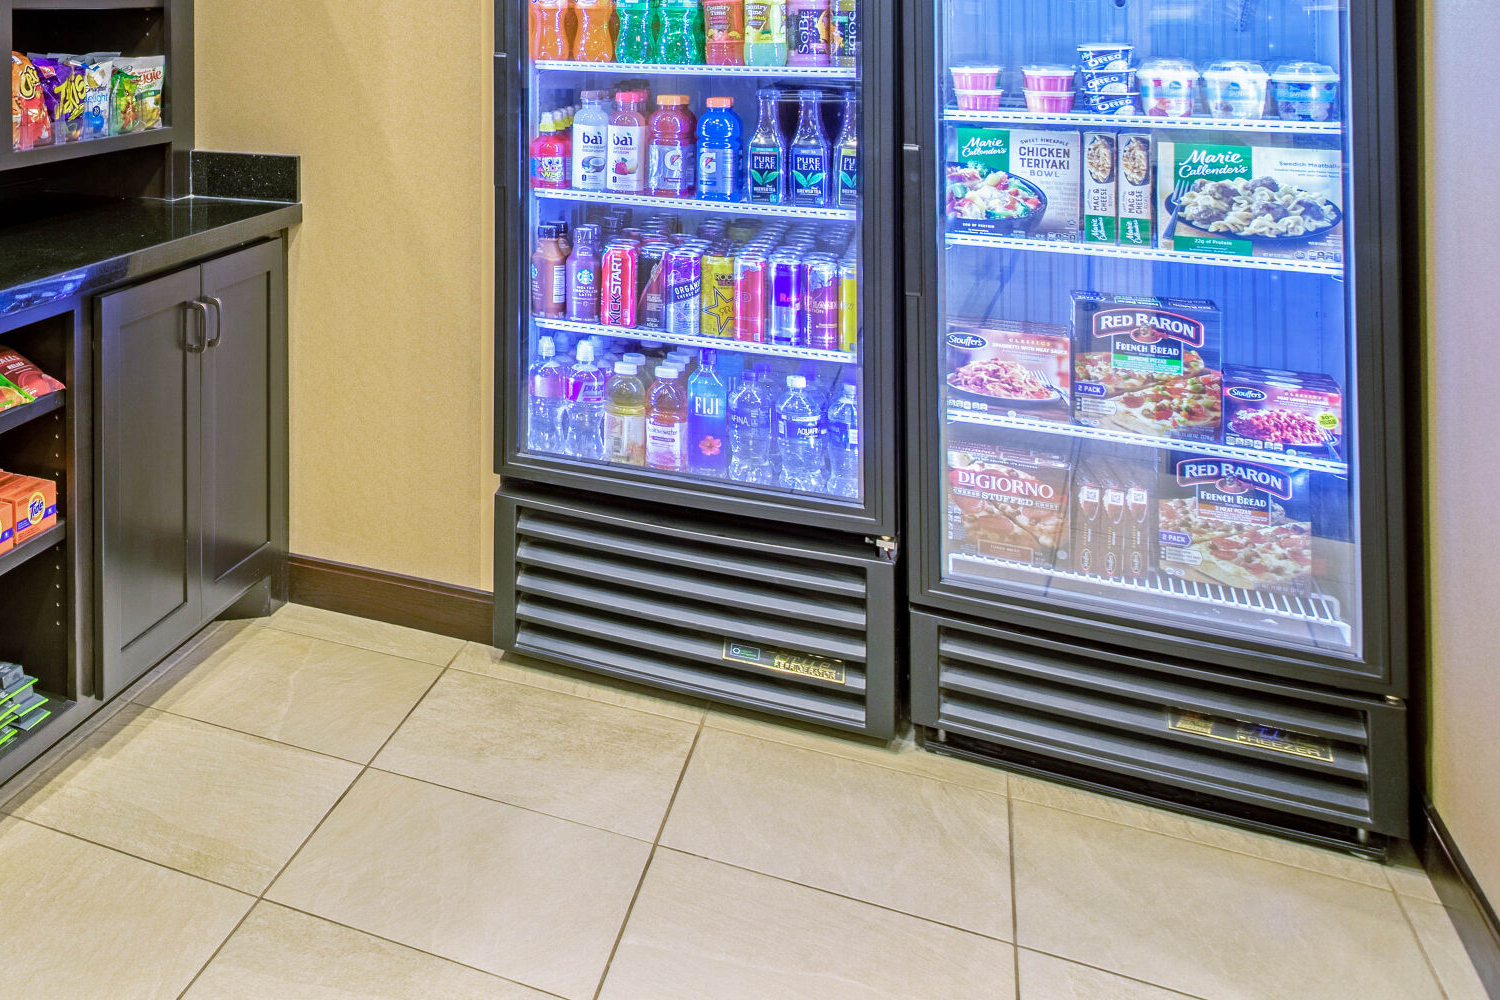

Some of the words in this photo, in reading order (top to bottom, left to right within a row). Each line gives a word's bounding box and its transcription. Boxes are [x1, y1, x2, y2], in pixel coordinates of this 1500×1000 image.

[1088, 52, 1123, 67] OREO
[1087, 76, 1120, 89] OREO
[1097, 98, 1132, 111] OREO
[582, 131, 603, 145] bai
[962, 137, 1004, 149] Marie
[962, 147, 1007, 158] Callender's
[1018, 146, 1070, 158] CHICKEN
[1179, 149, 1244, 166] Marie
[1019, 157, 1070, 170] TERIYAKI
[1278, 160, 1307, 168] Swedish
[1029, 169, 1060, 178] BOWL
[1179, 164, 1248, 178] Callender's
[1135, 189, 1143, 214] CHEESE
[1100, 314, 1132, 330] RED
[1135, 313, 1195, 339] BARON
[947, 334, 984, 348] Stouffer's
[1115, 341, 1148, 353] FRENCH
[1150, 344, 1180, 356] BREAD
[1084, 386, 1102, 394] PACK
[1230, 388, 1263, 400] Stouffer's
[694, 397, 720, 416] FIJI
[1184, 463, 1218, 479] RED
[1221, 462, 1283, 491] BARON
[981, 492, 1035, 508] STUFFED
[1200, 490, 1235, 504] FRENCH
[1236, 495, 1267, 508] BREAD
[29, 498, 44, 520] Tide
